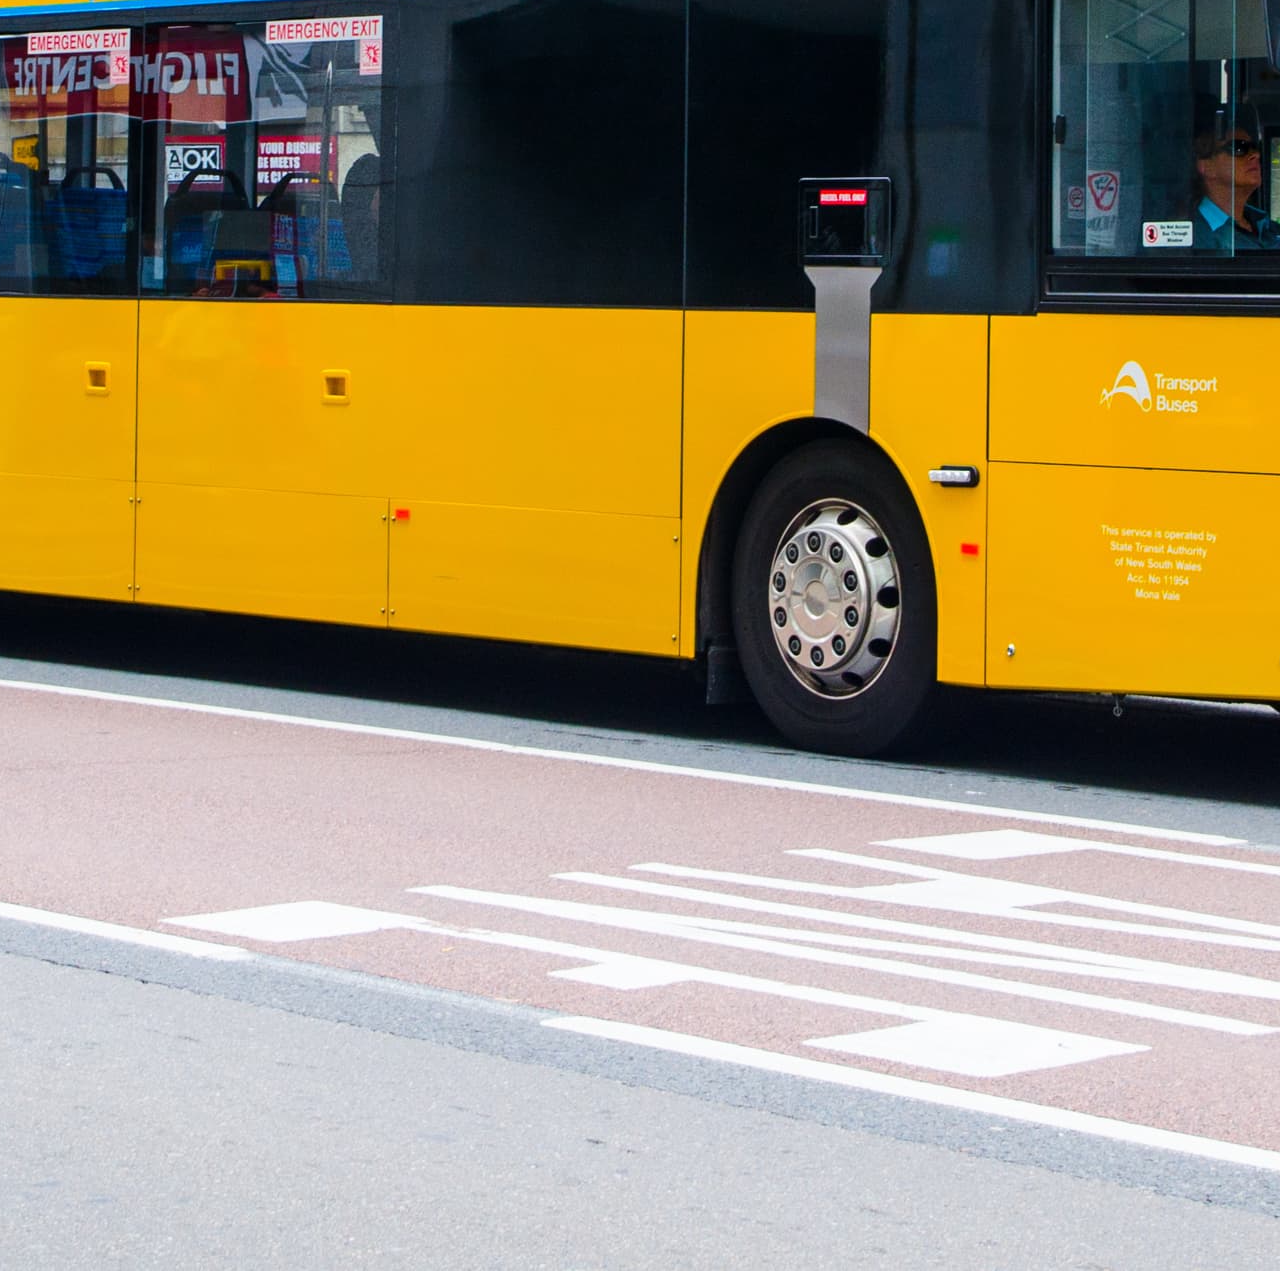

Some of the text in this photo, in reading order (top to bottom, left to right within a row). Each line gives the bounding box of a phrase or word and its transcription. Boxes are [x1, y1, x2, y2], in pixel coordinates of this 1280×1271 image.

[269, 19, 380, 40] EMERGENCY EXIT
[30, 31, 128, 51] EMERGENCY EXIT
[286, 142, 333, 155] BUSINES
[1154, 373, 1218, 394] Transport
[1156, 395, 1198, 413] Buses
[1101, 524, 1216, 543] This service is operated by
[1110, 540, 1207, 558] State Transit Authority
[1114, 557, 1202, 571] of New South Wales
[1135, 588, 1180, 600] Mona Vale
